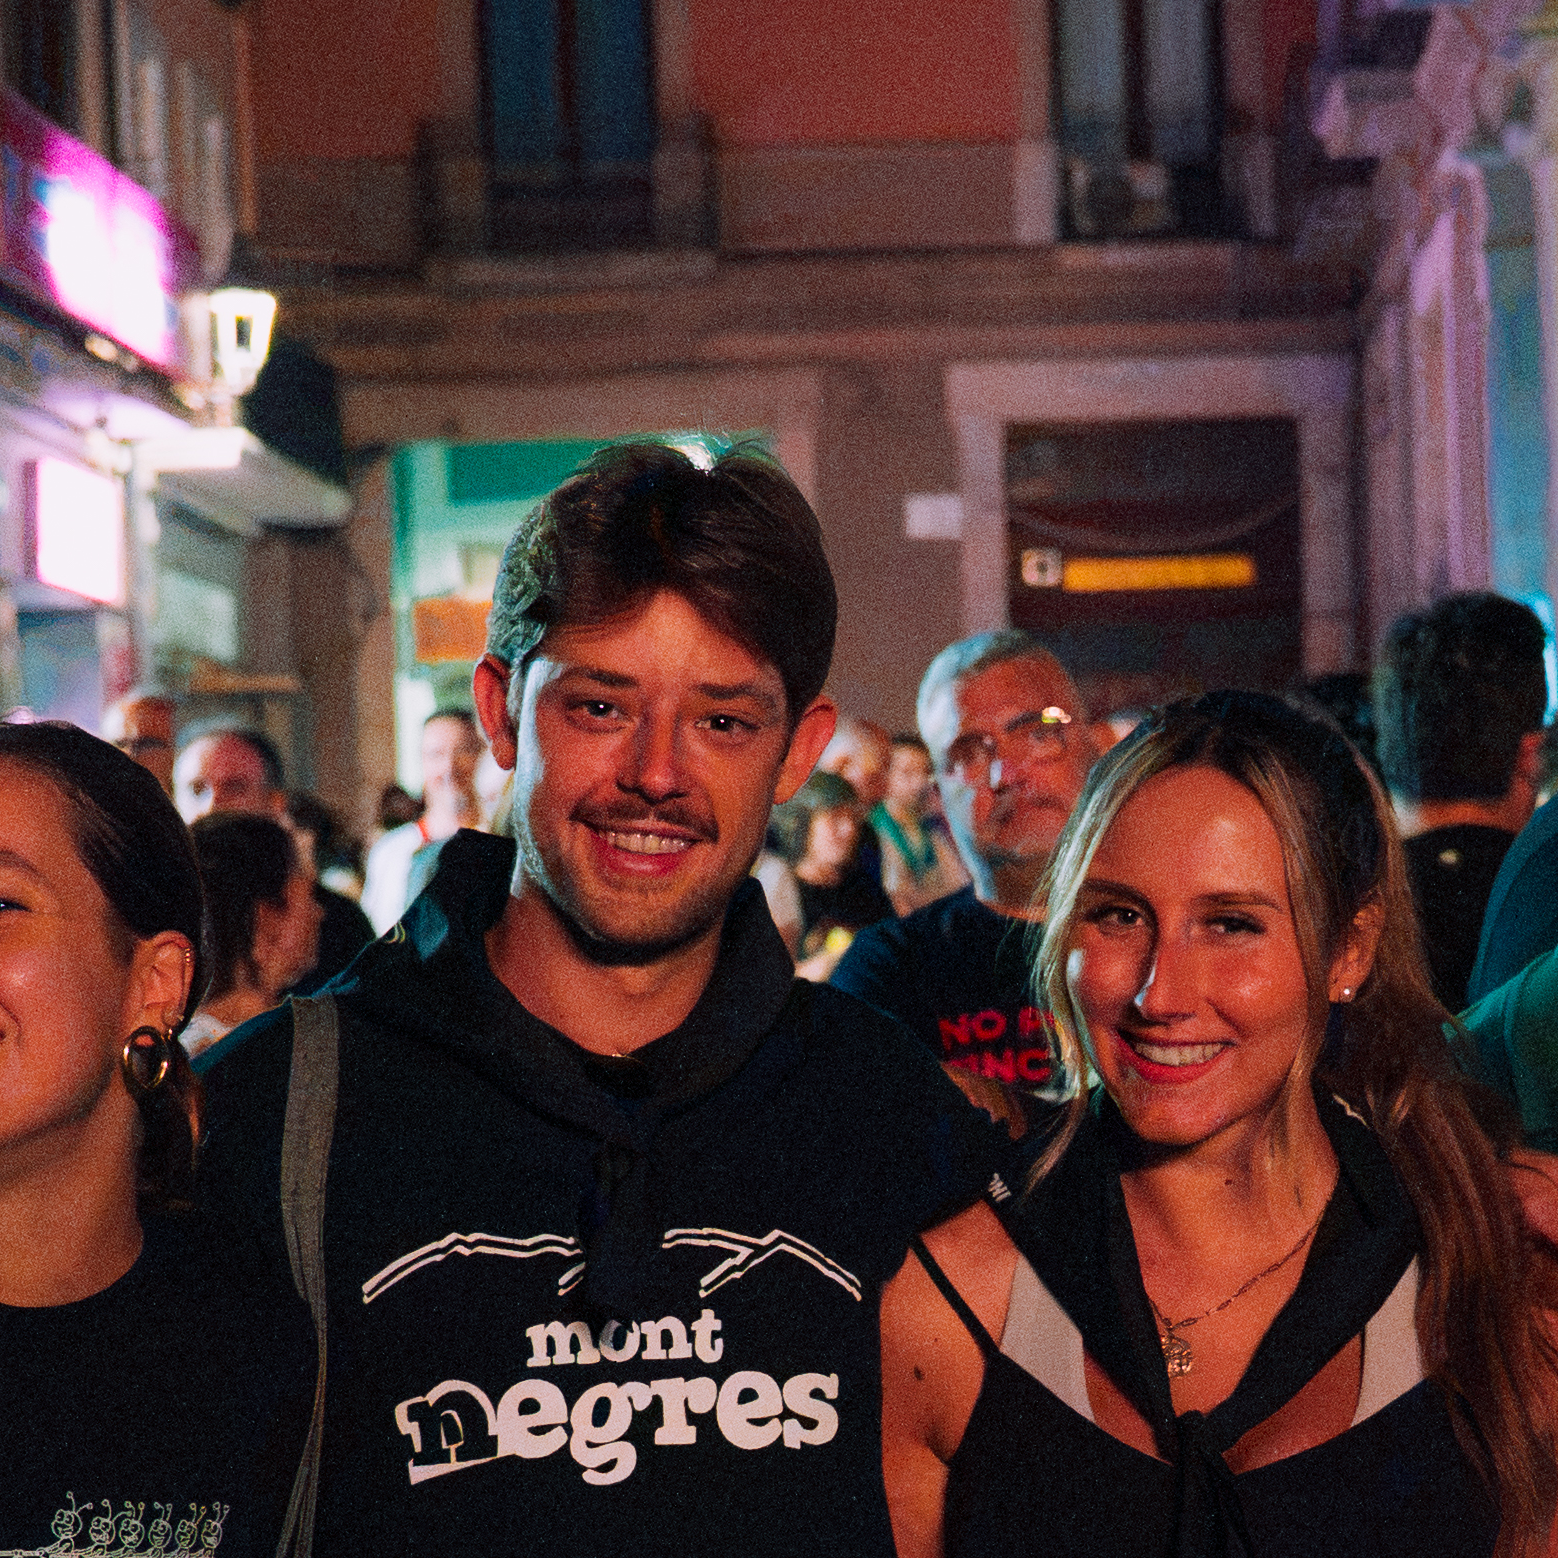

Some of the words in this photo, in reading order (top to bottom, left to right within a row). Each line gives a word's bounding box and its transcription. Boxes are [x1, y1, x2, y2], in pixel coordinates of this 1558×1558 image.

[939, 1009, 1007, 1050] NO
[526, 1308, 724, 1368] mont
[395, 1370, 840, 1486] negres
